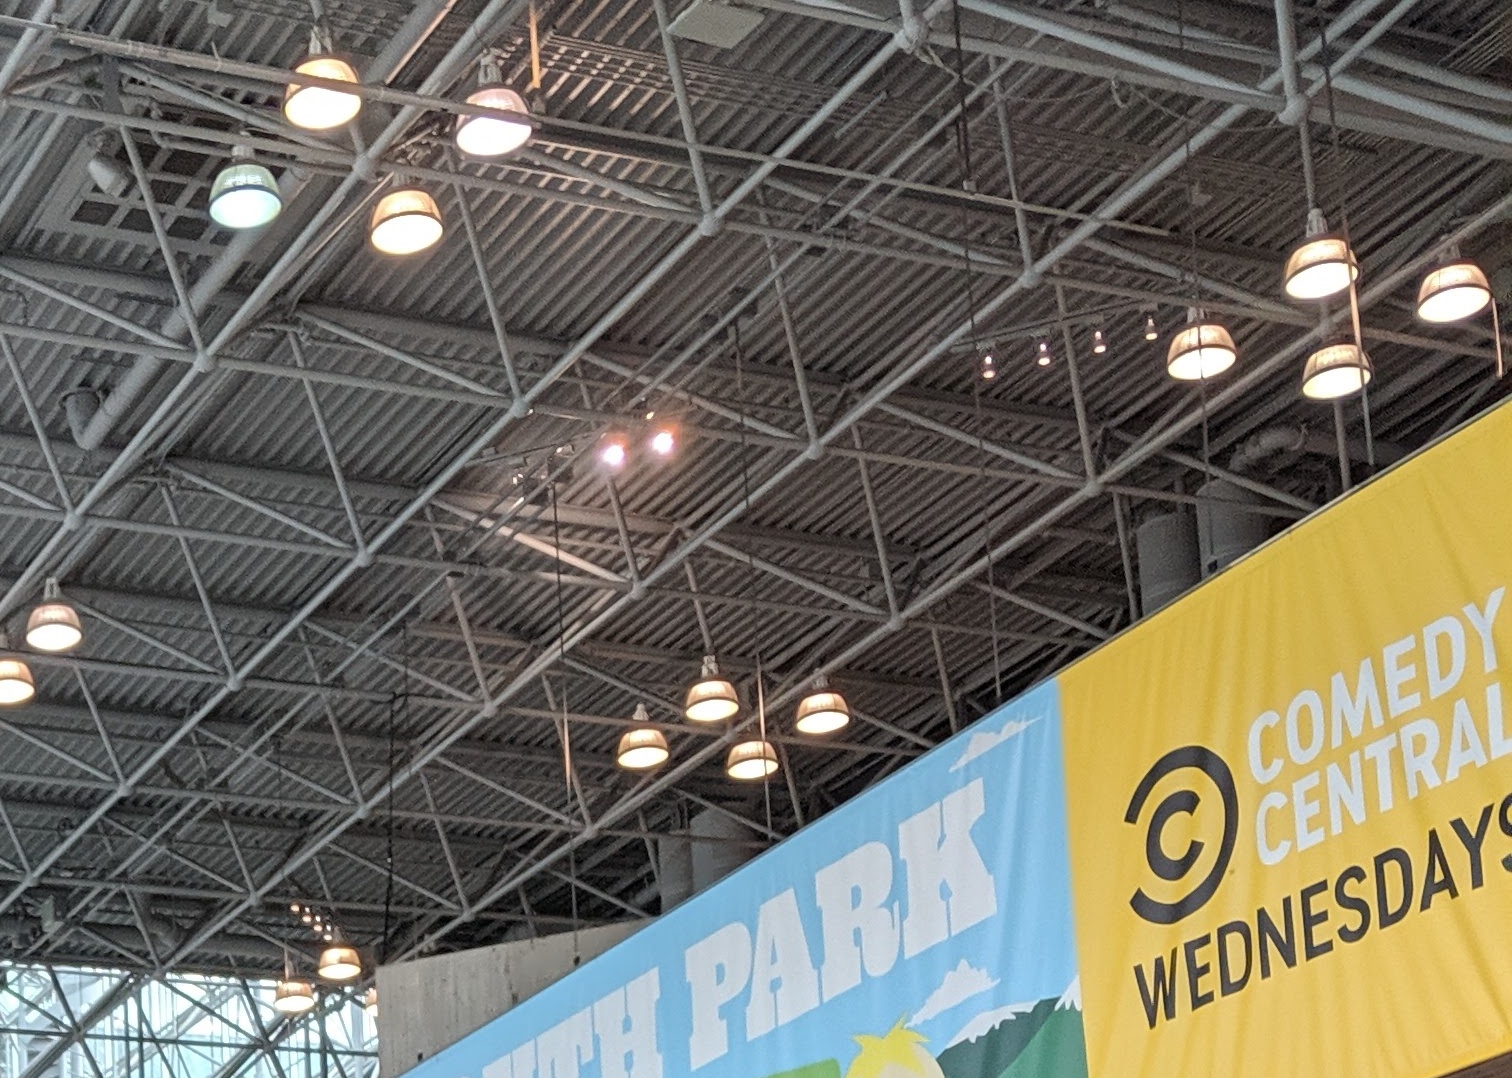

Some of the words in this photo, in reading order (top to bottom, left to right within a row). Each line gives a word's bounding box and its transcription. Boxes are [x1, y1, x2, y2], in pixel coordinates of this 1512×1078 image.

[1246, 586, 1507, 785] COMEDY
[1255, 682, 1512, 867] CENTRAL
[685, 777, 998, 1073] PARK
